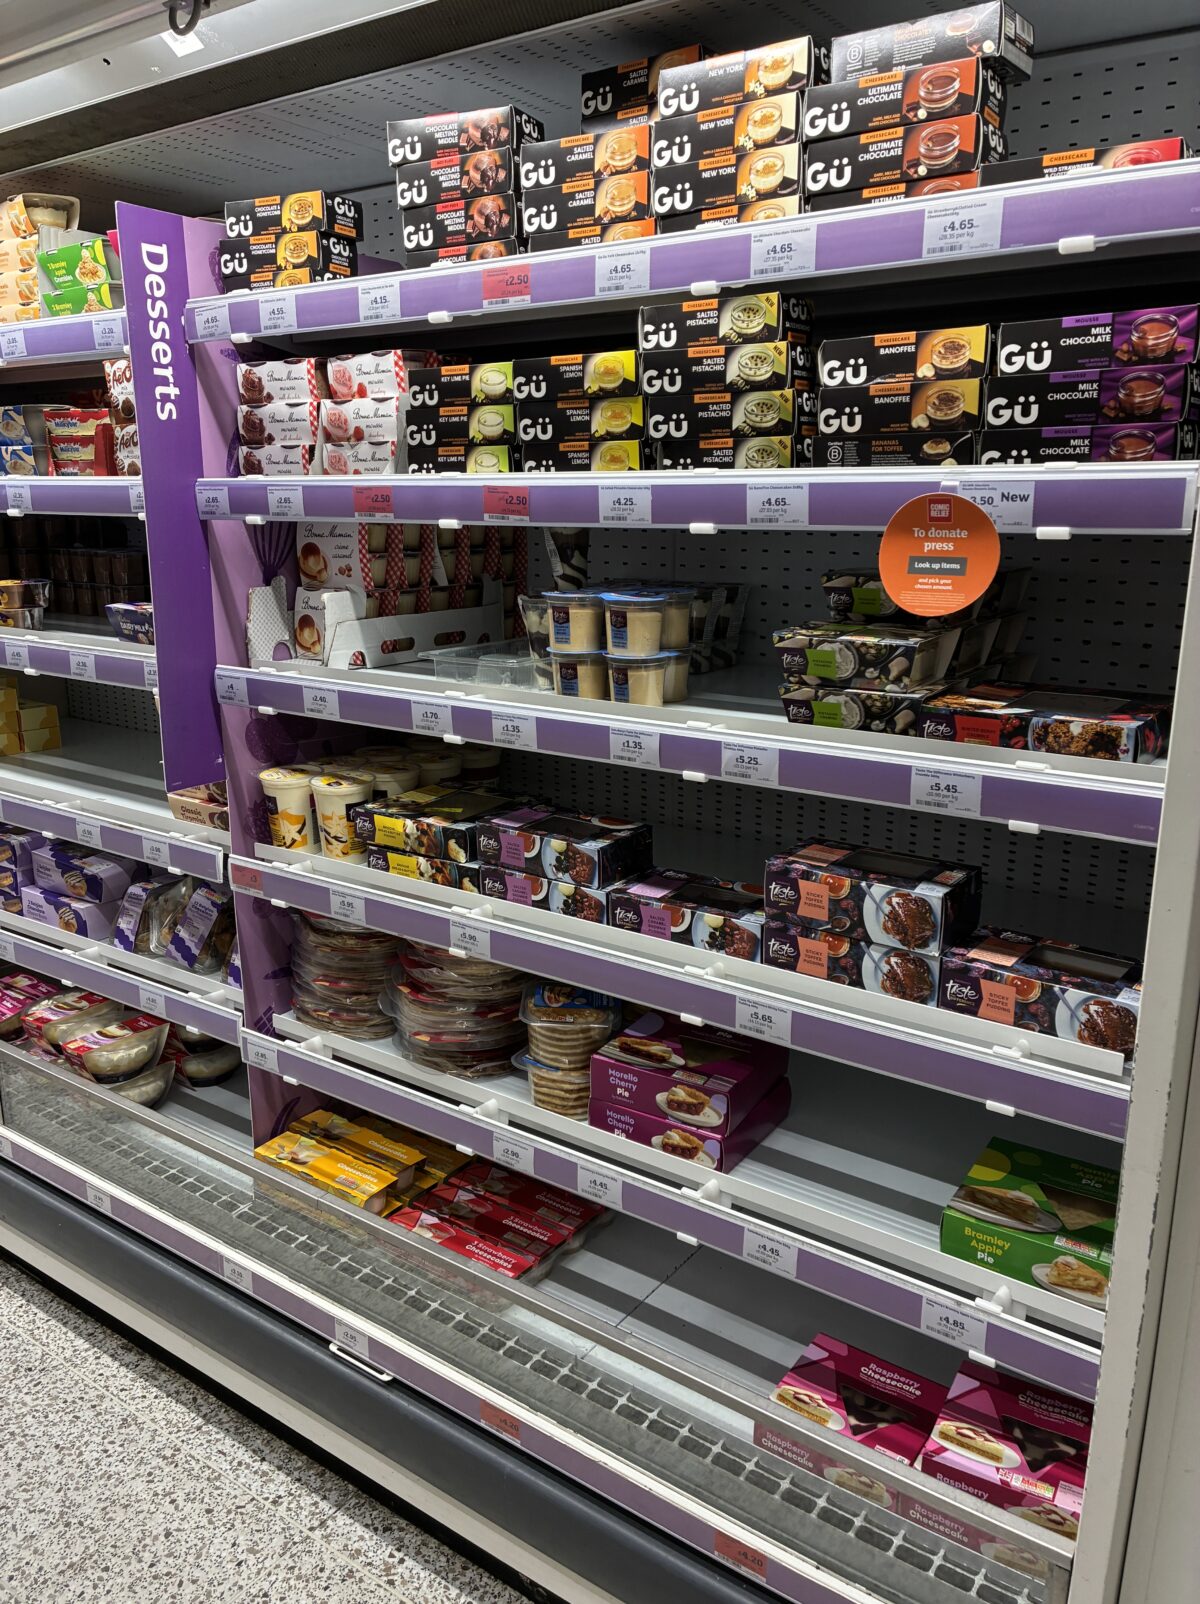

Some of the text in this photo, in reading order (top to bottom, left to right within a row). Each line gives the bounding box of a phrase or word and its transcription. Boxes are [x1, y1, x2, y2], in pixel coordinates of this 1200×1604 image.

[868, 83, 903, 96] ULTIMATE
[582, 86, 612, 116] Gü
[659, 83, 700, 116] Gü
[857, 91, 902, 105] CHOCOLATE
[700, 117, 734, 131] NEW YORK
[805, 102, 850, 137] Gü
[426, 123, 458, 134] CHOCOLATE
[435, 130, 458, 140] MELTING
[438, 137, 458, 146] MIDDLE
[869, 139, 903, 152] ULTIMATE
[388, 138, 422, 164] Gü
[566, 151, 594, 162] CARAMEL
[574, 145, 594, 155] SALTED
[653, 135, 692, 168] Gü
[858, 148, 902, 162] CHOCOLATE
[1050, 152, 1088, 163] CHEESECAKE
[430, 167, 460, 178] CHOCOLATE
[439, 174, 460, 183] MELTING
[521, 159, 556, 189] Gü
[702, 166, 736, 179] NEW YORK
[807, 157, 852, 192] Gü
[440, 179, 460, 189] MIDDLE
[398, 179, 428, 207] Gü
[575, 191, 595, 200] SALTED
[654, 182, 693, 214] Gü
[334, 196, 357, 218] Gü
[568, 197, 595, 208] CARAMEL
[436, 211, 465, 221] CHOCOLATE
[444, 217, 465, 227] MELTING
[523, 207, 558, 232] Gü
[226, 215, 253, 238] Gü
[447, 223, 466, 232] MIDDLE
[944, 218, 974, 232] £4.65
[404, 222, 434, 249] Gü
[329, 237, 352, 258] Gü
[767, 243, 793, 256] £4.65
[220, 253, 248, 275] Gü
[610, 264, 632, 275] £4.65
[505, 274, 529, 287] £2.50
[370, 297, 388, 306] £4.15
[764, 296, 774, 308] NEW
[697, 310, 718, 319] SALTED
[687, 317, 718, 327] PISTACHIO
[140, 241, 181, 421] Desserts
[643, 322, 677, 349] Gü
[1091, 326, 1112, 335] MILK
[1060, 334, 1111, 346] CHOCOLATE
[773, 344, 785, 357] NEW
[879, 345, 916, 355] BANOFFEE
[703, 357, 725, 365] SALTED
[1000, 341, 1052, 373] Gü
[560, 365, 582, 373] SPANISH
[563, 371, 582, 379] LEMON
[692, 365, 725, 373] PISTACHIO
[823, 358, 867, 387] Gü
[513, 375, 546, 399] Gü
[643, 367, 682, 394] Gü
[1078, 382, 1099, 391] MILK
[409, 384, 438, 407] Gü
[779, 392, 791, 404] NEW
[874, 396, 910, 404] BANOFFEE
[1047, 391, 1098, 401] CHOCOLATE
[566, 408, 590, 416] SPANISH
[698, 410, 731, 418] PISTACHIO
[987, 395, 1039, 426] Gü
[650, 413, 688, 439] Gü
[820, 406, 862, 434] Gü
[407, 424, 436, 446] Gü
[519, 418, 552, 441] Gü
[1070, 438, 1090, 446] MILK
[1040, 447, 1090, 455] CHOCOLATE
[371, 494, 390, 503] £2.50
[505, 495, 527, 506] £2.50
[613, 497, 634, 507] £4.25
[762, 497, 787, 507] £4.65
[1001, 491, 1030, 503] New
[930, 510, 949, 518] RELIEF
[912, 527, 968, 538] To donate
[924, 542, 954, 553] press
[931, 562, 940, 570] up
[781, 653, 807, 667] taste
[422, 711, 439, 720] £1.70
[788, 704, 813, 719] taste
[502, 724, 521, 734] £1.35
[922, 719, 953, 739] taste
[623, 740, 643, 750] £1.35
[736, 755, 759, 766] £5.25
[930, 782, 958, 794] £5.45
[180, 805, 202, 816] Classic
[769, 882, 798, 902] taste
[806, 891, 823, 899] STICKY
[804, 901, 825, 910] PUDDING
[614, 906, 640, 925] taste
[461, 932, 477, 942] £5.90
[768, 938, 797, 957] taste
[945, 979, 979, 1000] taste
[988, 997, 1009, 1007] TOFFEE
[989, 992, 1009, 1001] STICKY
[986, 1003, 1011, 1013] PUDDING
[751, 1011, 773, 1024] £5.65
[608, 1068, 638, 1083] Morello
[609, 1076, 637, 1092] Cherry
[617, 1087, 630, 1098] Pie
[606, 1109, 635, 1125] Morello
[607, 1117, 634, 1134] Cherry
[590, 1178, 608, 1190] £4.45
[502, 1218, 548, 1242] Cheesecakes
[514, 1216, 553, 1237] Strawberry
[964, 1227, 1011, 1250] Bramley
[478, 1241, 518, 1264] Strawberry
[758, 1243, 780, 1257] £4.45
[970, 1238, 1003, 1257] Apple
[465, 1244, 513, 1269] Cheesecakes
[977, 1251, 995, 1264] Pie
[940, 1315, 965, 1330] £4.85
[860, 1366, 922, 1396] Cheesecake
[868, 1362, 921, 1388] Raspberry
[1018, 1394, 1089, 1423] Cheesecake
[1026, 1390, 1086, 1414] Raspberry
[765, 1431, 810, 1458] Raspberry
[761, 1437, 814, 1469] Cheesecake
[936, 1472, 989, 1500] Raspberry
[914, 1504, 965, 1533] Raspberry
[909, 1509, 969, 1543] Cheesecake
